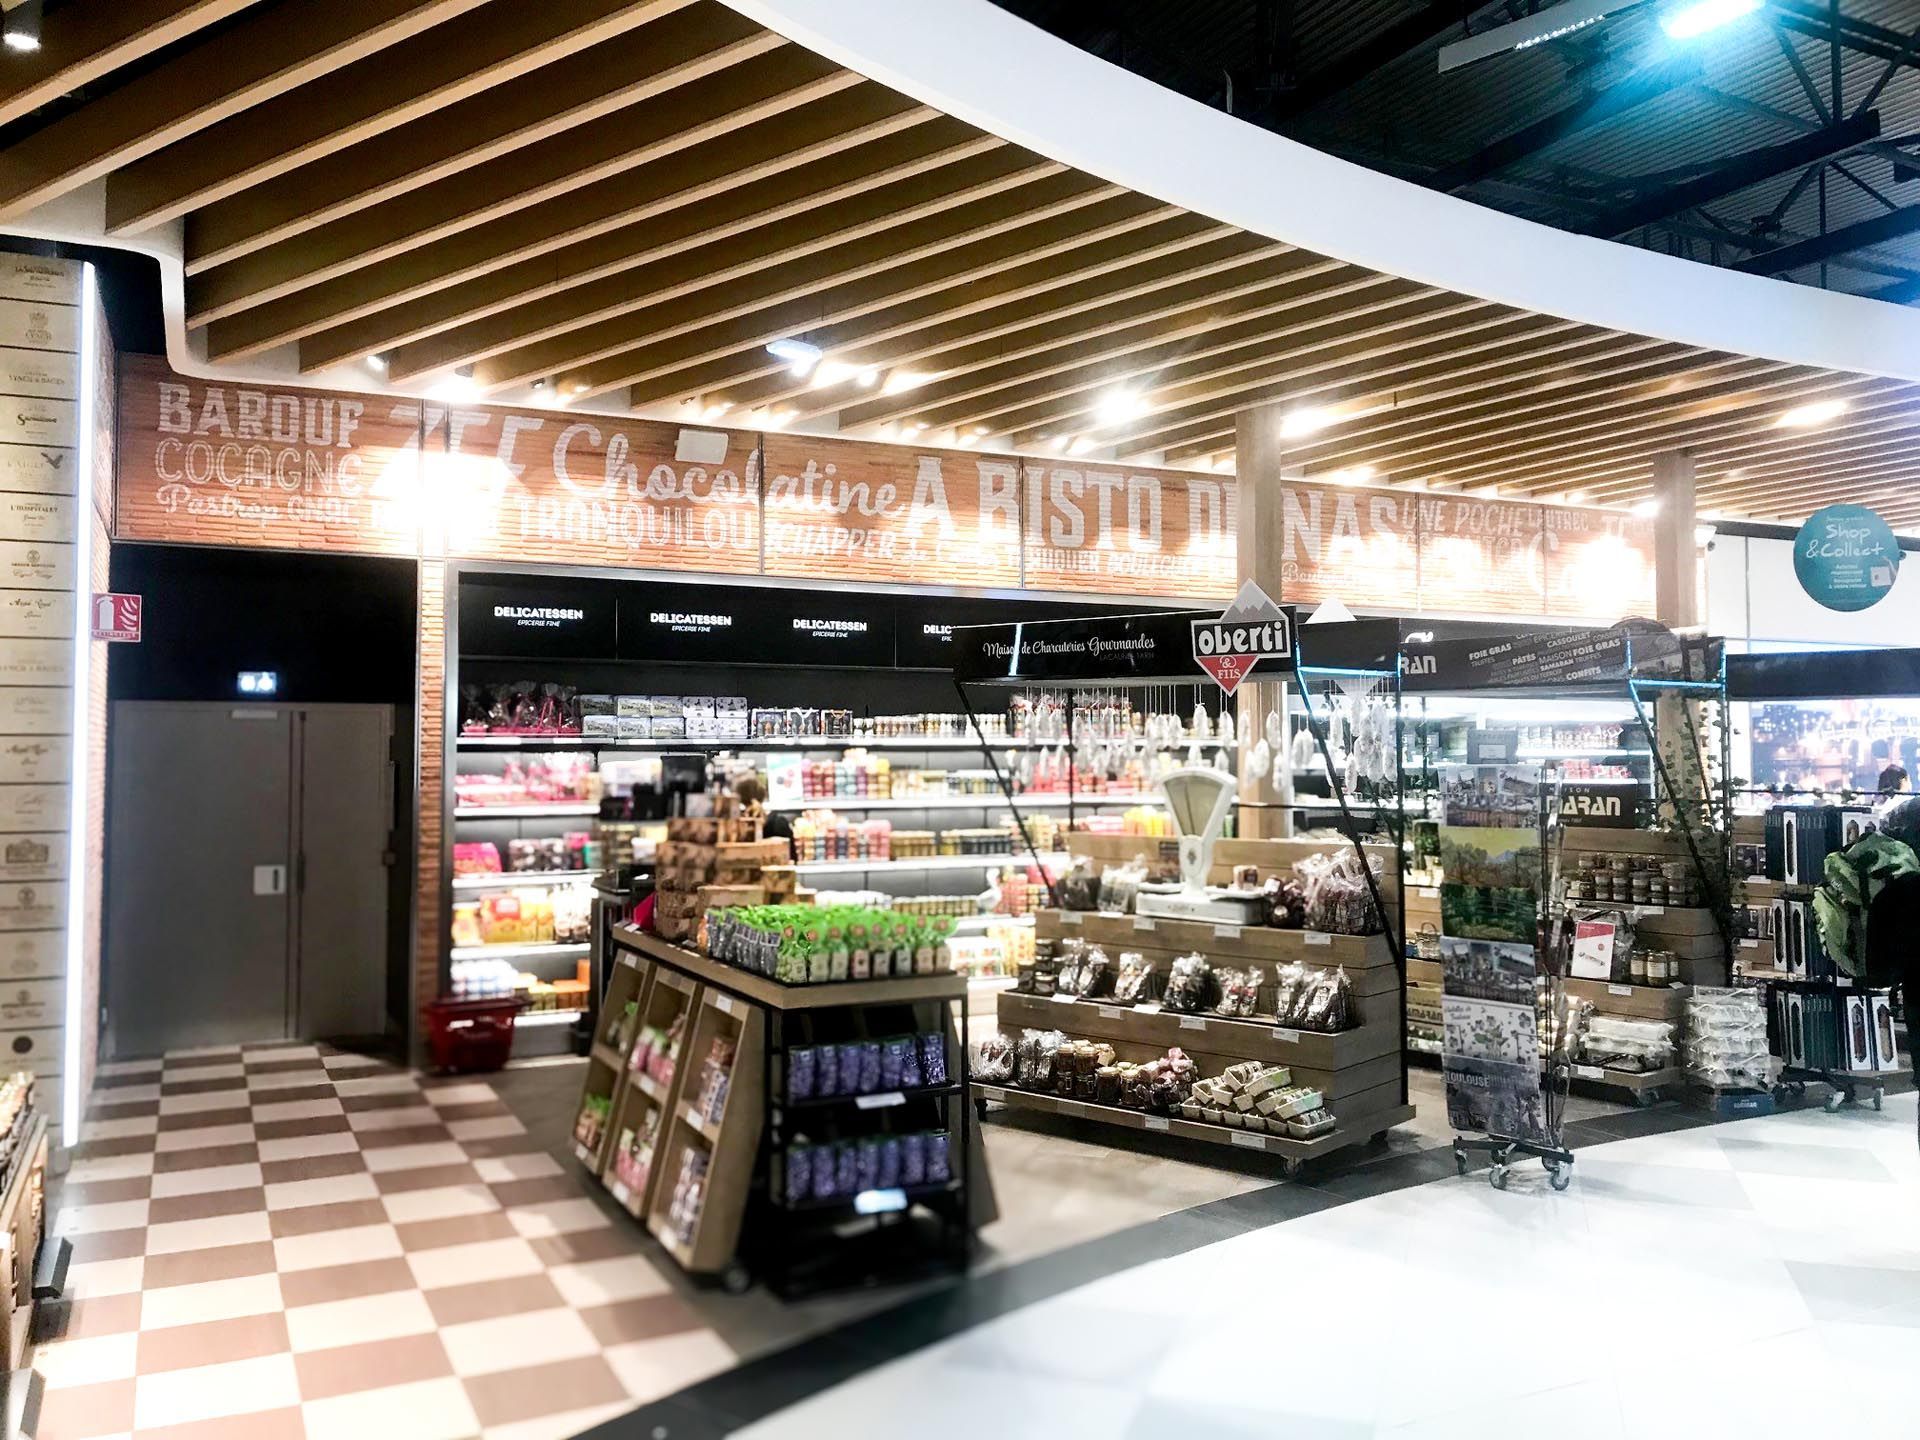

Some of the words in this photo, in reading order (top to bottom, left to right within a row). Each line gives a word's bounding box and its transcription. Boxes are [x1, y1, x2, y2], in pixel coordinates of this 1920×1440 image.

[154, 437, 363, 497] COCAGNE
[553, 422, 907, 519] Chocolatine
[902, 455, 957, 536] A
[976, 456, 1163, 554] BISTO
[1402, 498, 1448, 532] UNE
[1455, 502, 1528, 537] POCHE
[1825, 523, 1871, 544] Shop
[493, 606, 583, 620] DELICATESSEN
[650, 612, 732, 626] DELICATESSEN
[793, 619, 868, 632] DELICATESSEN
[983, 642, 1017, 658] Maiso
[1021, 641, 1031, 655] de
[1032, 640, 1085, 655] Charcuteries
[1087, 633, 1155, 656] Gourmandes
[1198, 621, 1284, 655] oberti
[1546, 631, 1591, 648] CASSOULET
[1468, 650, 1488, 661] FOIE
[1489, 643, 1512, 655] GRAS
[1573, 645, 1594, 657] FOIE
[1595, 638, 1620, 651] GRAS
[1217, 668, 1241, 680] FILS
[1566, 666, 1601, 680] CONFITS
